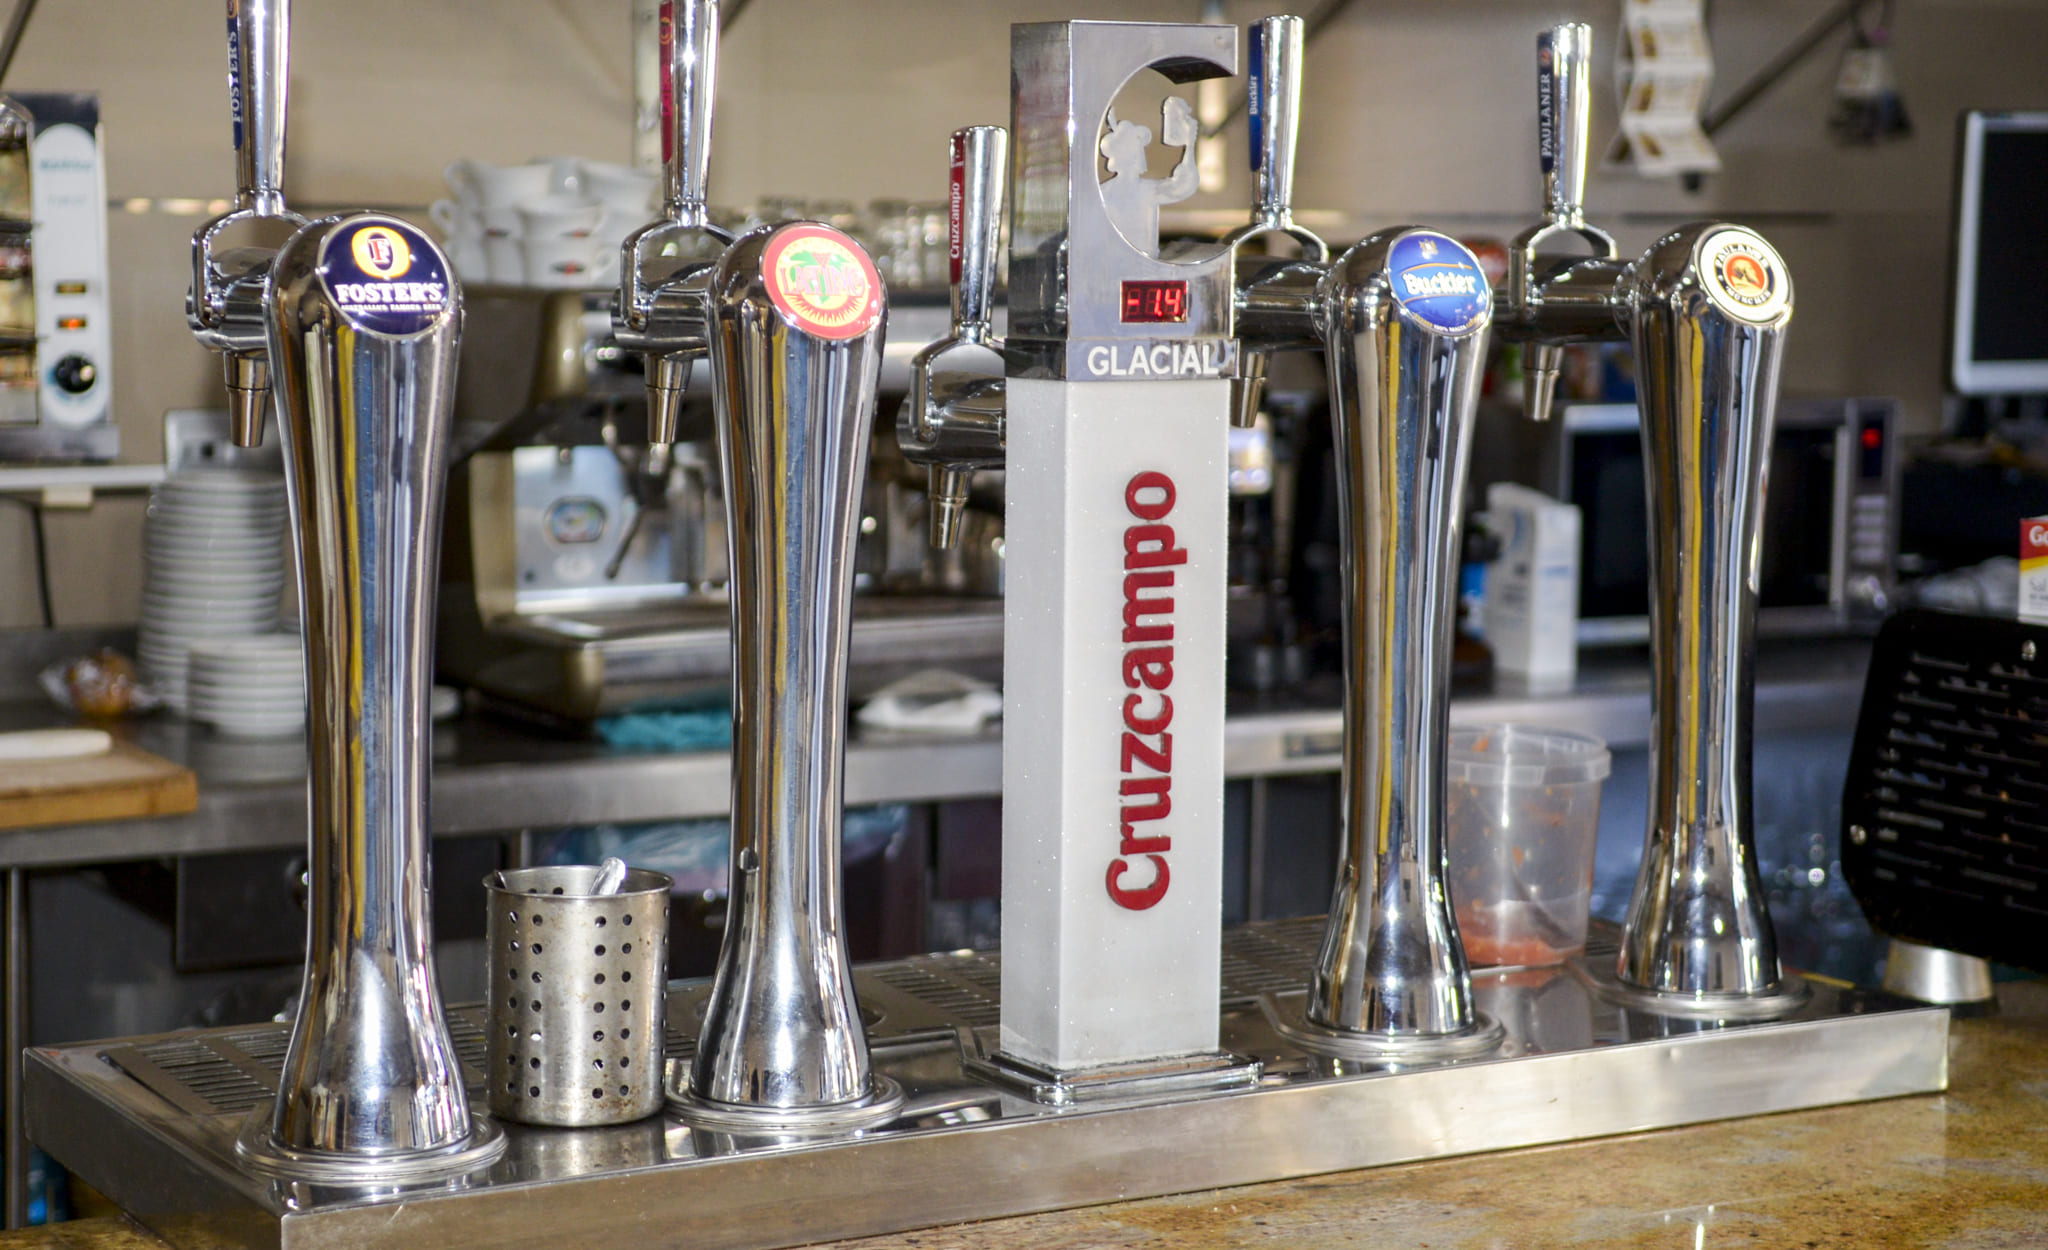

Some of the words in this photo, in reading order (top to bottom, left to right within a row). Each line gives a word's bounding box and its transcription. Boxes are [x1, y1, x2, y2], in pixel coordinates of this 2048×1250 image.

[1249, 75, 1259, 115] Buckler
[1540, 73, 1552, 157] PAULANER
[949, 182, 961, 259] Cruzcampo
[334, 282, 443, 303] FOSTER'S
[1403, 272, 1476, 295] Buckler
[1087, 344, 1219, 376] GLACIAL
[1105, 470, 1188, 911] Cruzcampo
